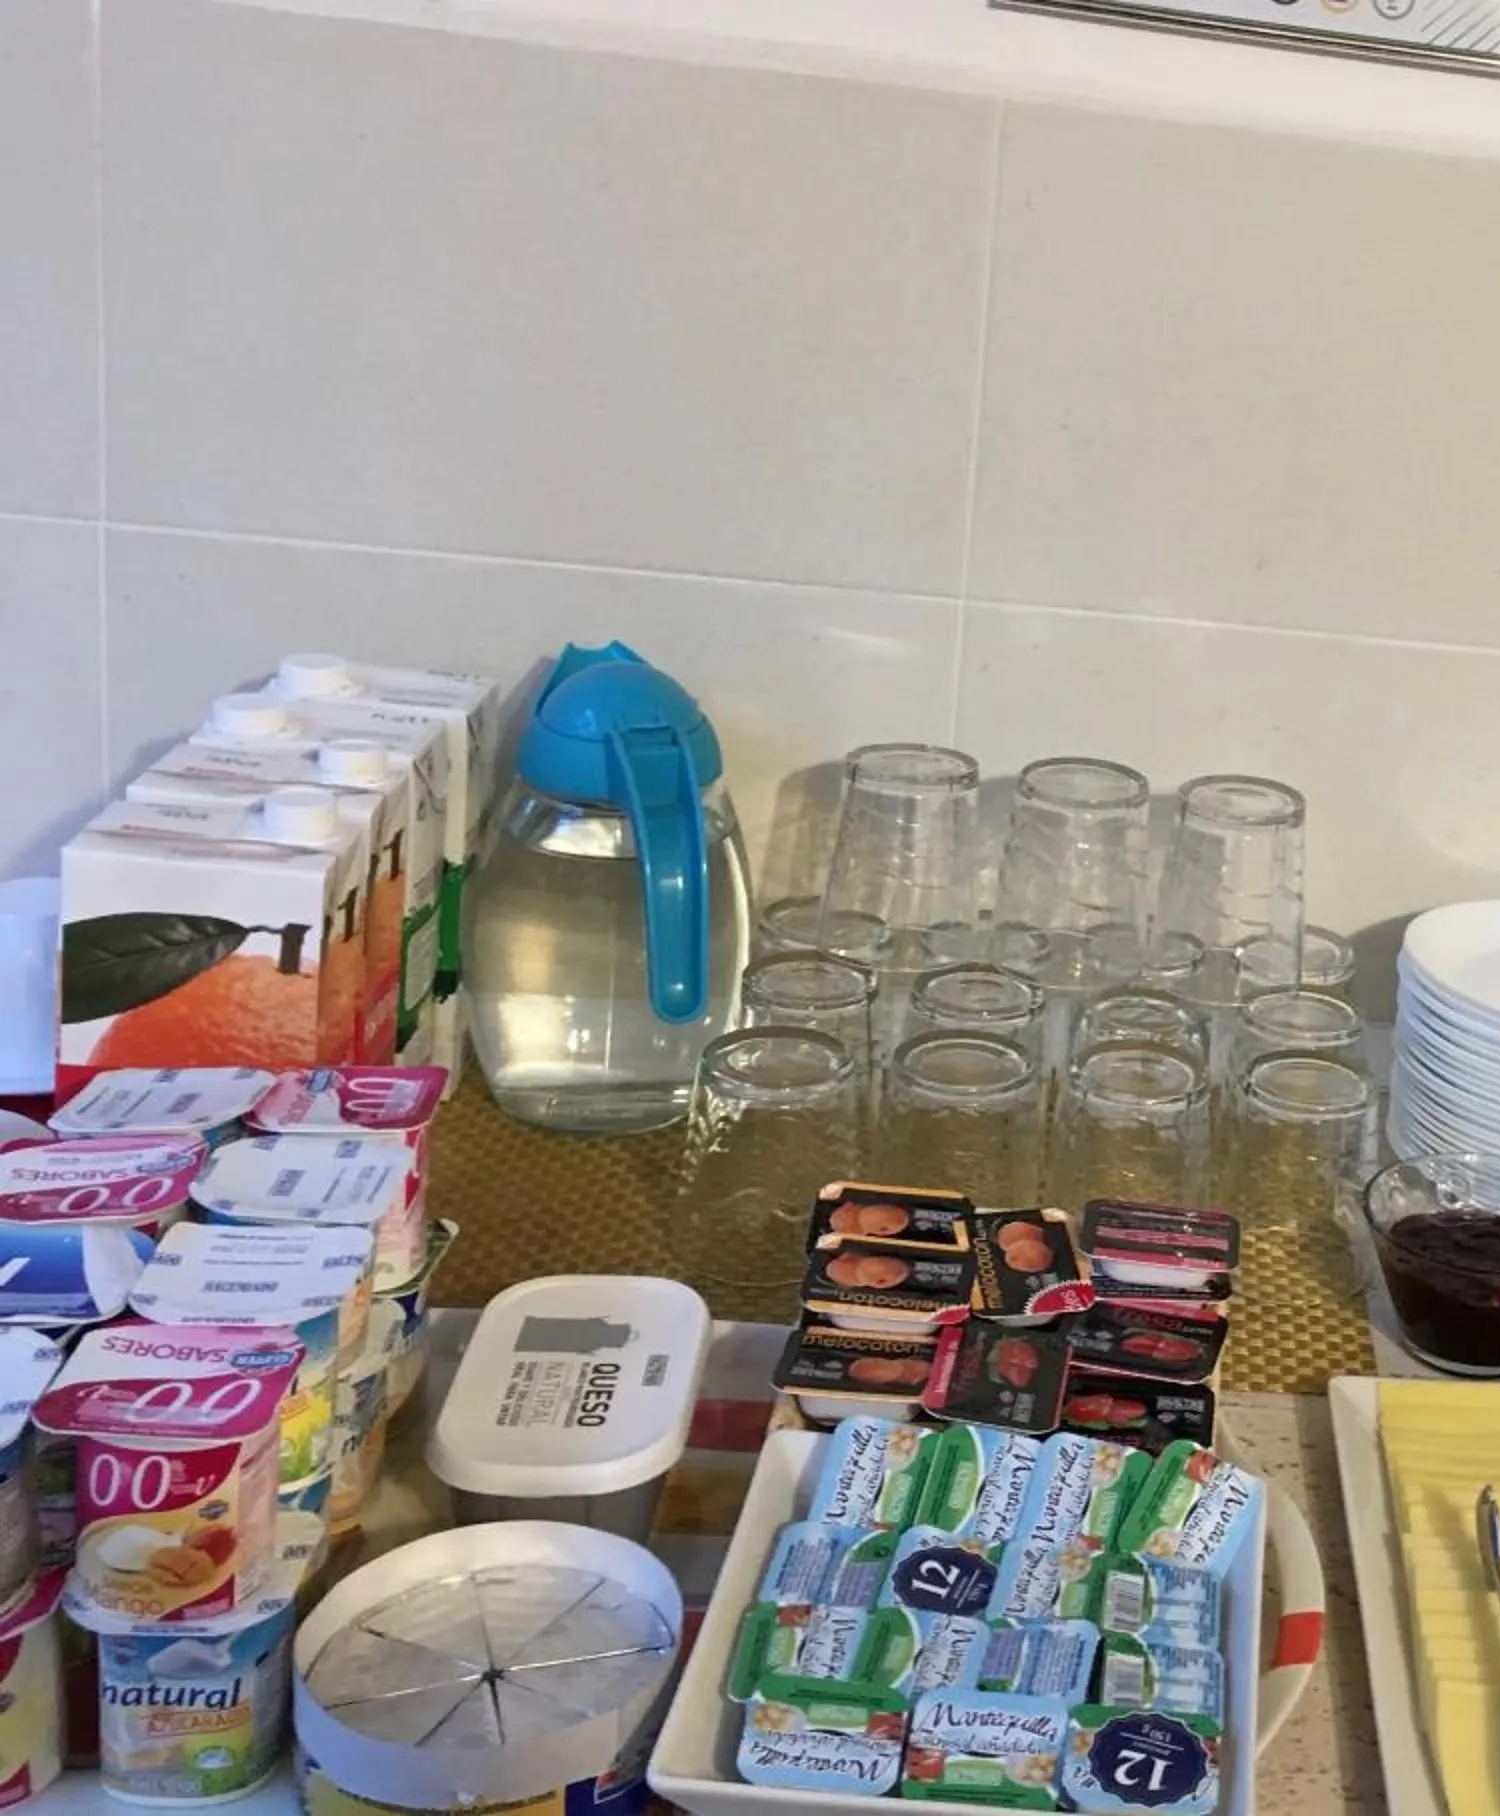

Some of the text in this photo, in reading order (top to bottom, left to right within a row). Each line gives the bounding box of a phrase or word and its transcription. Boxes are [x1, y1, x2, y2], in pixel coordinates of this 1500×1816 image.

[11, 1167, 128, 1182] SABORES
[101, 1335, 229, 1363] SABORES
[525, 1361, 566, 1428] NATURAL
[576, 1362, 621, 1427] QUESO
[911, 1559, 960, 1600] 12
[102, 1677, 241, 1710] natural
[915, 1701, 1058, 1742] Mantequilla
[751, 1740, 897, 1782] Mantequilla
[1113, 1749, 1175, 1792] 12
